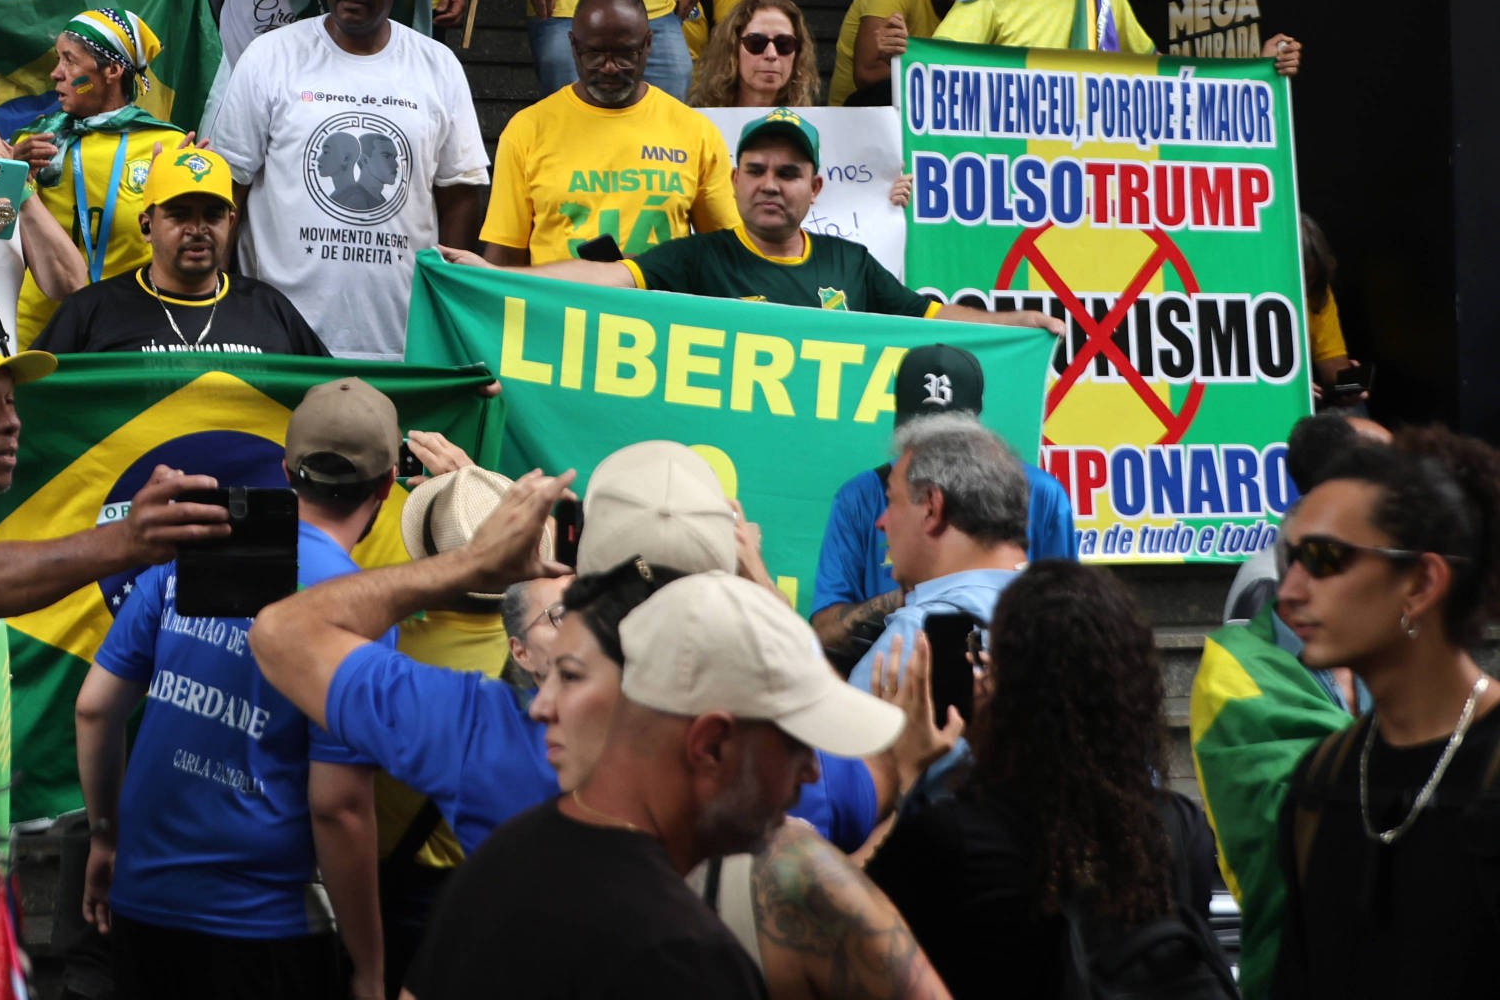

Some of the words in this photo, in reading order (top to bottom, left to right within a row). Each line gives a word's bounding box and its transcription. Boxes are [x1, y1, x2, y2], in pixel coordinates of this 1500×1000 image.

[314, 91, 418, 111] @preto_de_direita
[909, 67, 925, 130] O
[932, 69, 981, 132] BEM
[987, 72, 1081, 142] VENCEU,
[1086, 76, 1175, 145] PORQUE
[1180, 66, 1191, 141] É
[1199, 82, 1272, 143] MAIOR
[641, 145, 687, 164] MND
[568, 169, 685, 194] ANISTIA
[827, 165, 873, 183] nos
[915, 155, 1270, 227] BOLSOTRUMP
[299, 227, 372, 245] MOVIMENTO
[376, 231, 408, 249] NEGRO
[321, 245, 338, 260] DE
[343, 246, 392, 264] DIREITA
[920, 295, 1295, 380] UNISMO
[1103, 523, 1133, 555] de
[1140, 521, 1193, 555] tudo
[1202, 526, 1215, 553] e
[173, 749, 209, 779] CARLA
